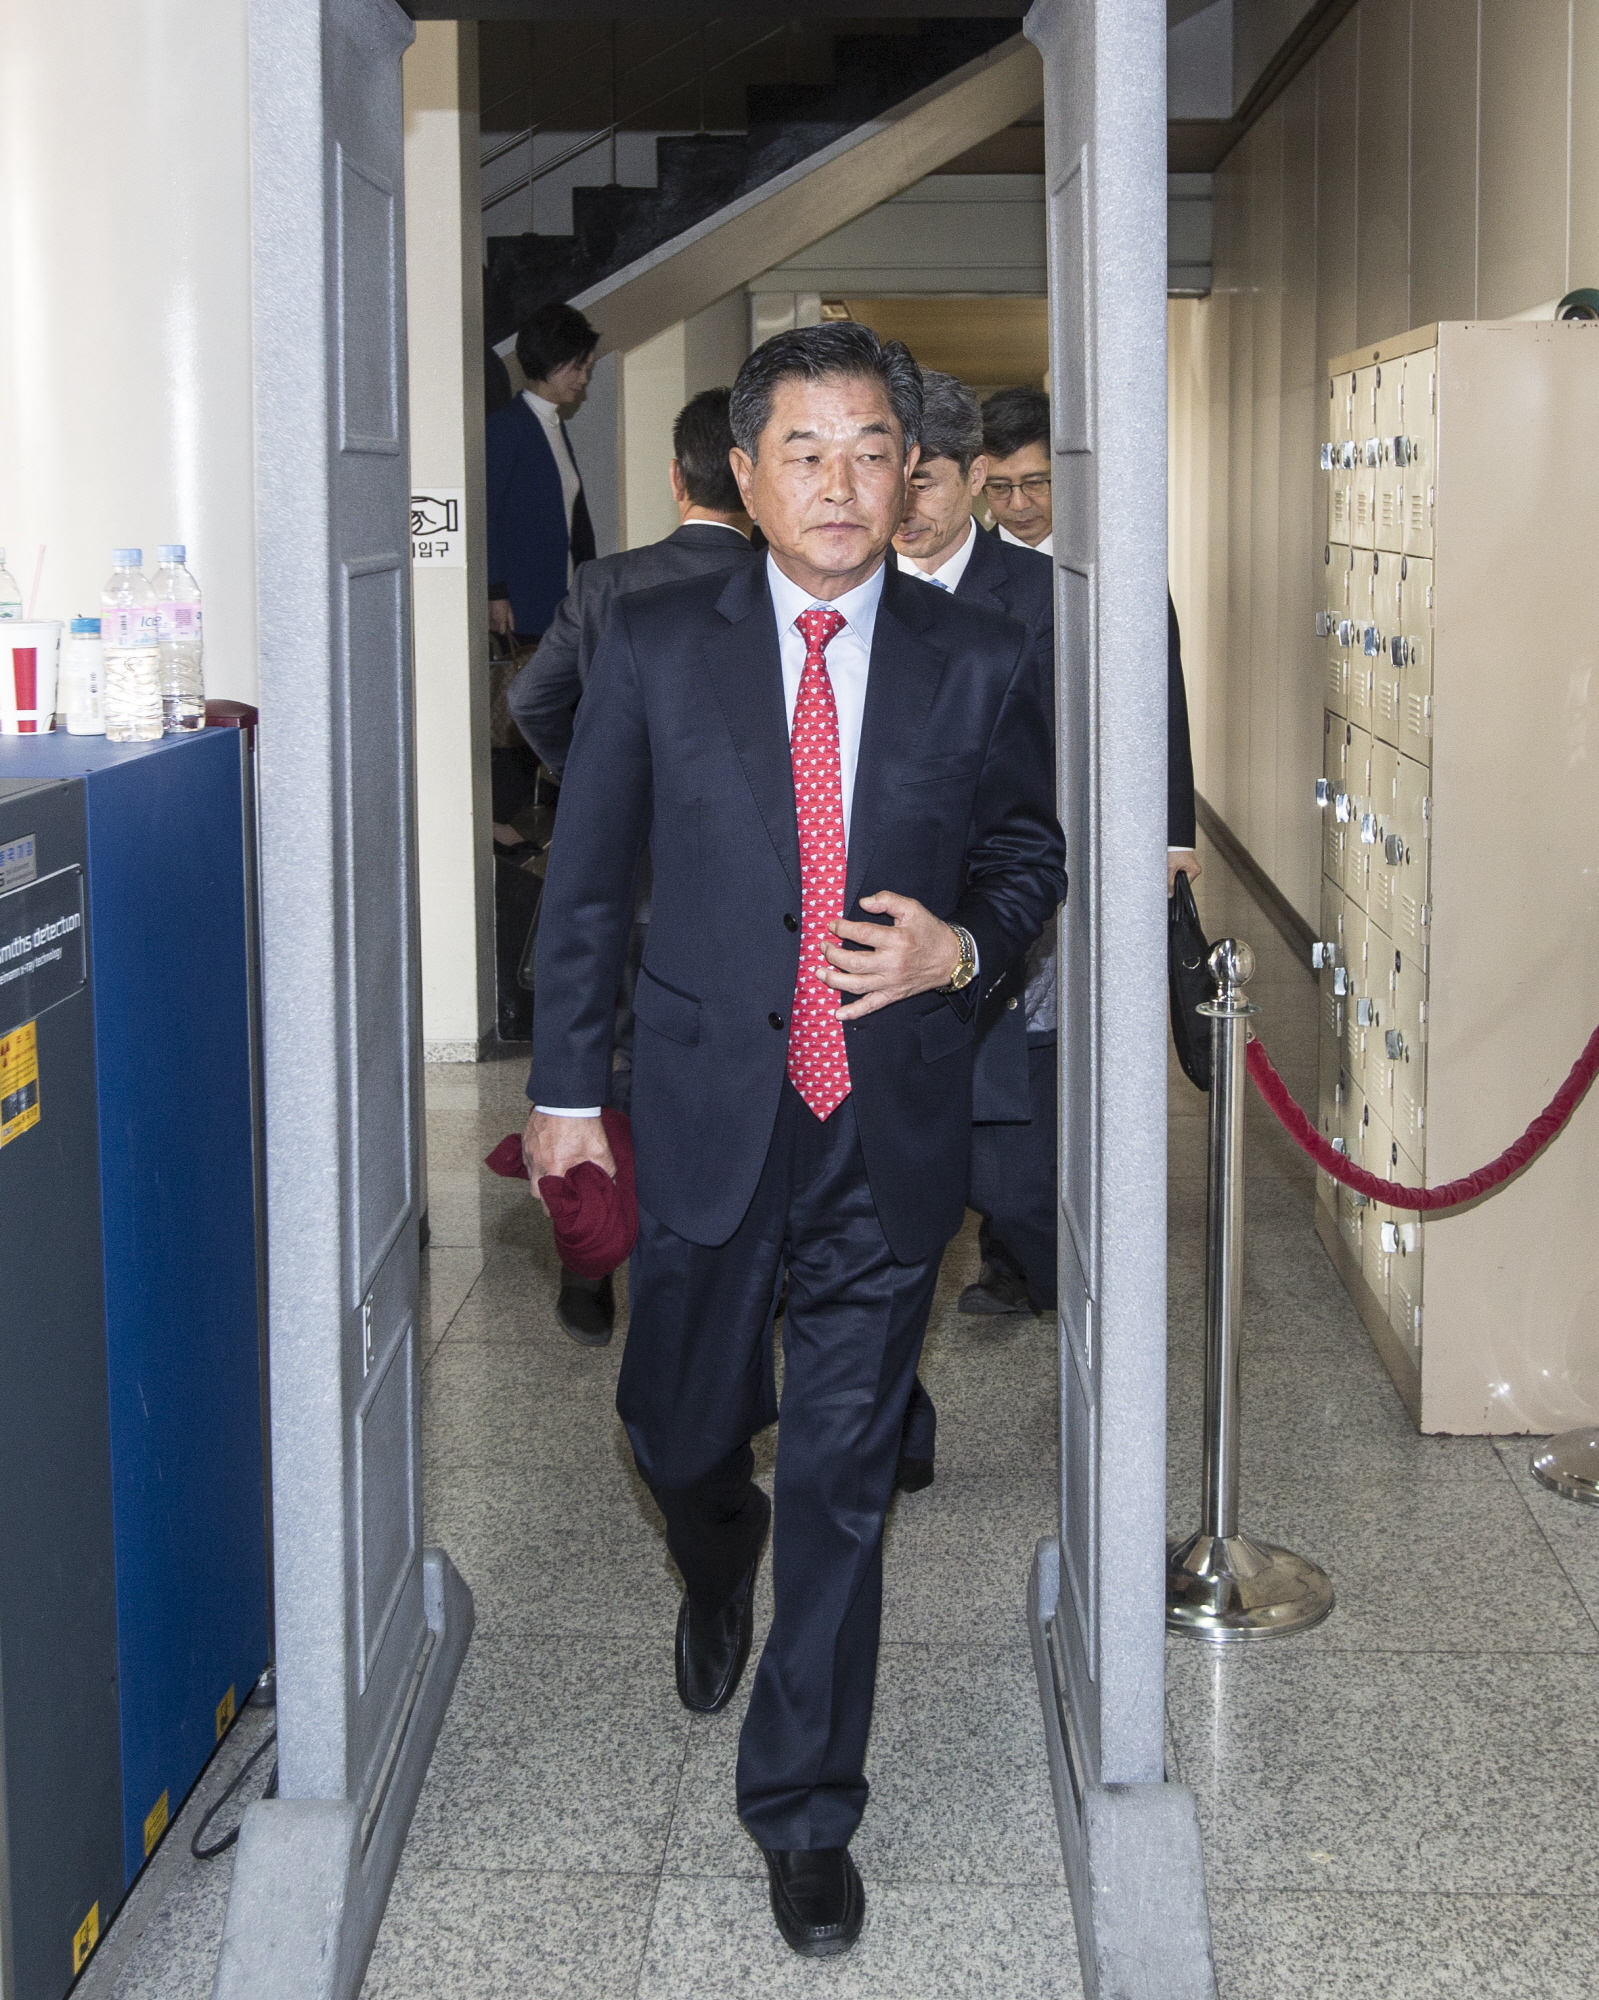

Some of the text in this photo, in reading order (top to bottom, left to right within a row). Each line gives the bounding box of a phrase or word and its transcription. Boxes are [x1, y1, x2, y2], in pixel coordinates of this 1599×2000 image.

[0, 912, 81, 964] miths detection
[35, 946, 63, 967] technology
